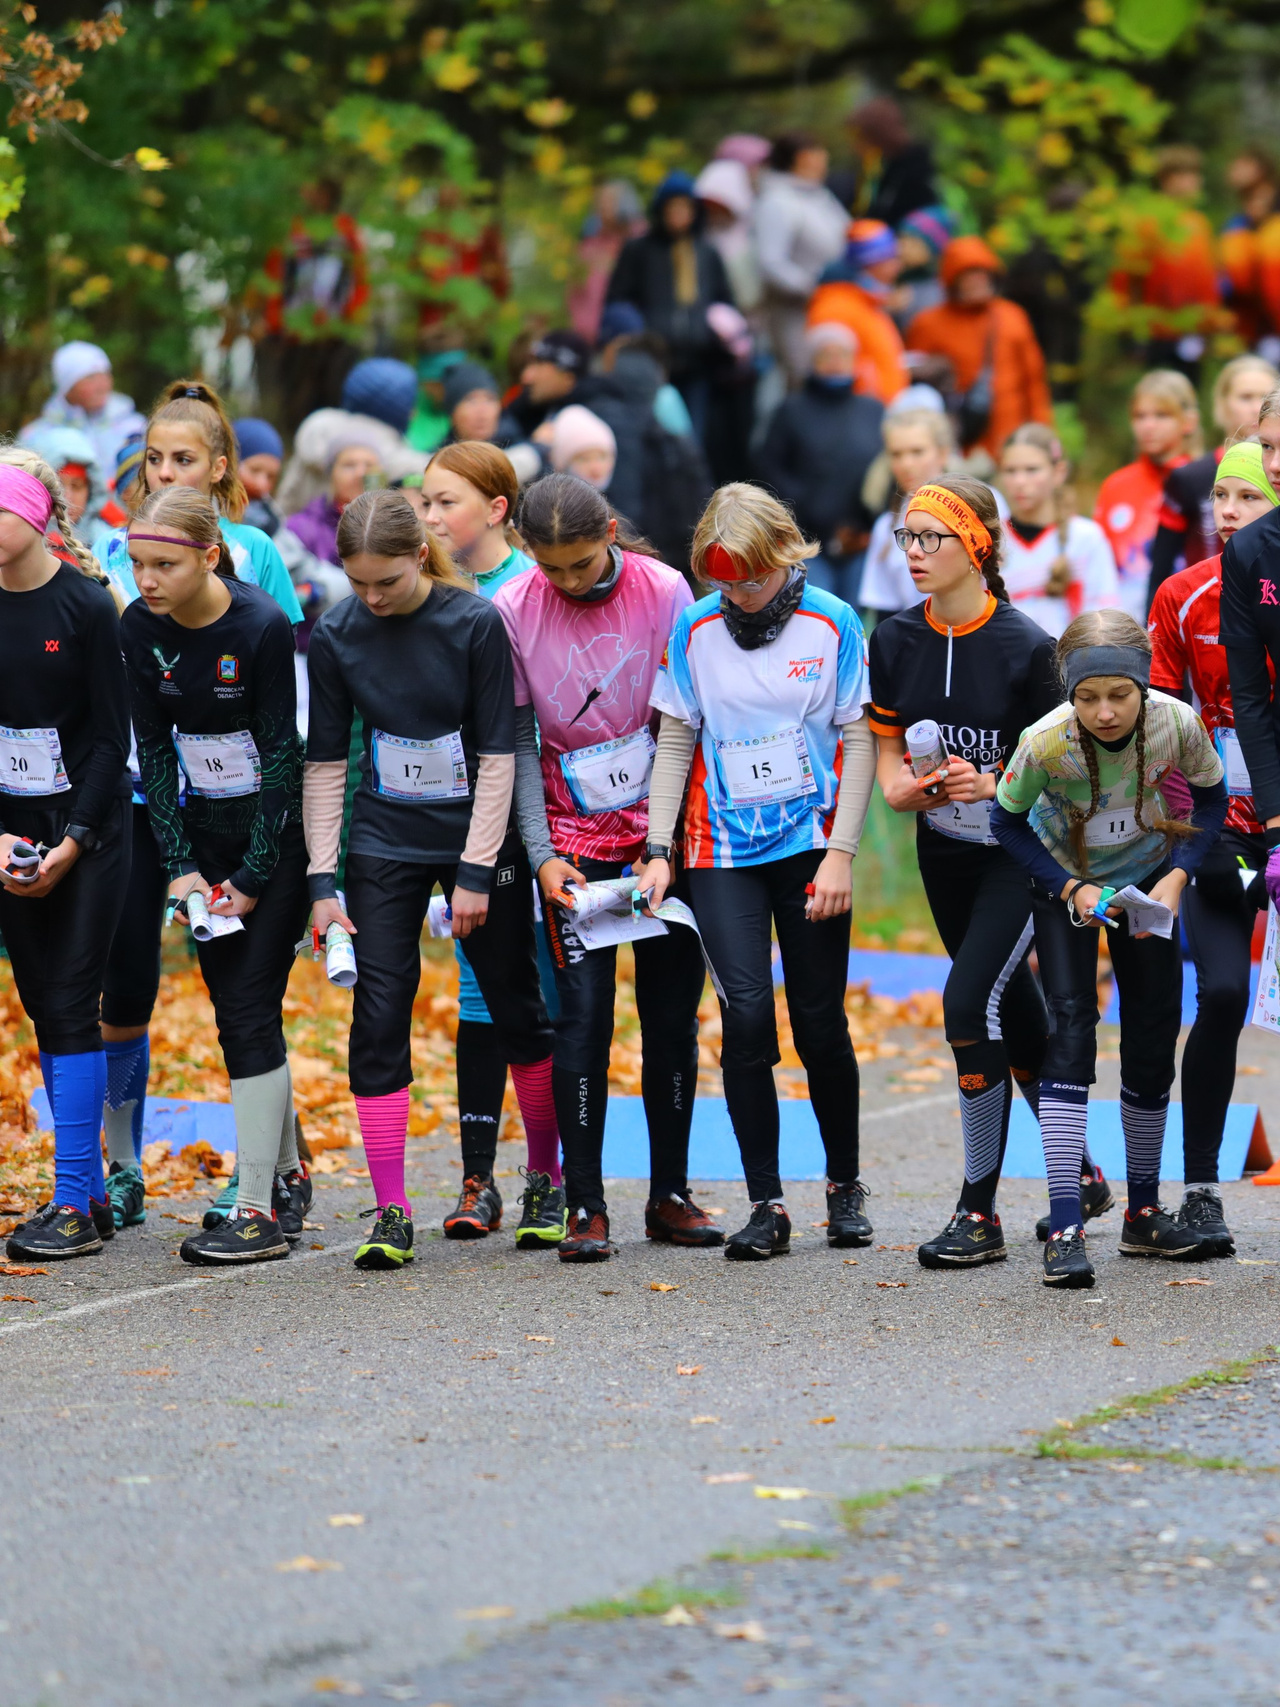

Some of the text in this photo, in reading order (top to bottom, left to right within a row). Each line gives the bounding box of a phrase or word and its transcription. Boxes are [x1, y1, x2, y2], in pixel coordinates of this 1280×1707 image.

[10, 756, 28, 773] 20
[205, 757, 224, 773] 18
[403, 764, 422, 780] 17
[751, 761, 772, 780] 15
[608, 768, 629, 788] 16
[1109, 820, 1126, 833] 11
